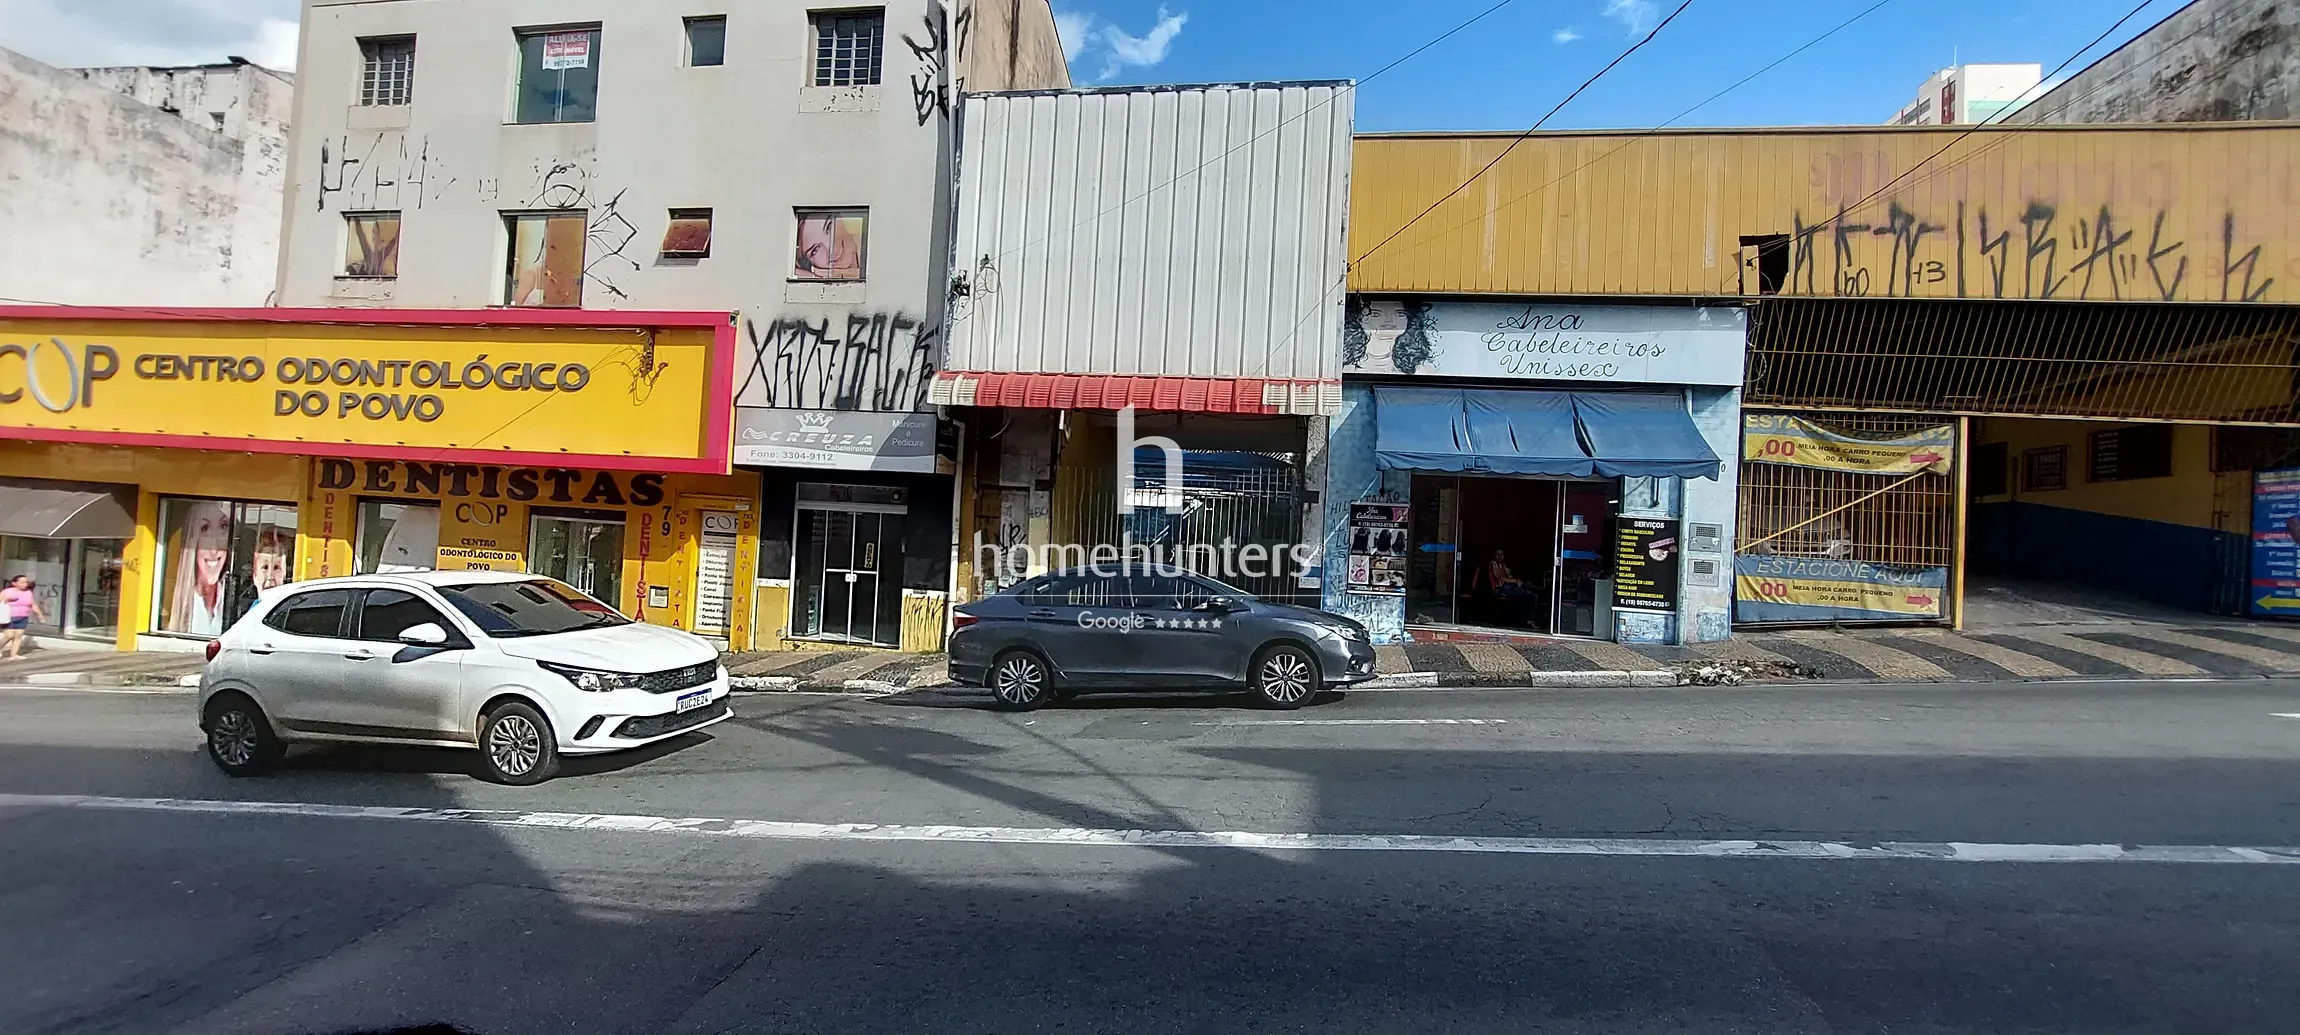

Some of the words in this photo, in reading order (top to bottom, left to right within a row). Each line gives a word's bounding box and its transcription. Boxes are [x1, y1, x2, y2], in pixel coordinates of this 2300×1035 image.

[1496, 306, 1585, 330] Ana
[1481, 330, 1666, 357] Cabeleireiros
[1499, 352, 1619, 377] Unissex
[0, 338, 120, 413] COP
[134, 354, 265, 383] CENTRO
[277, 354, 591, 392] ODONTOLÓGICO
[274, 390, 329, 417] DO
[338, 392, 444, 422] POVO
[892, 419, 926, 429] Manicure
[769, 432, 873, 445] CREUZA
[892, 438, 924, 447] Pedicure
[824, 444, 873, 453] Cabeleireiros
[1798, 443, 1816, 451] MEIA
[1818, 445, 1841, 453] HORA
[1842, 447, 1870, 455] CARRO
[750, 450, 779, 458] Fone:
[782, 451, 833, 461] 3304-9112
[1846, 457, 1871, 465] HORA
[318, 458, 667, 506] DENTISTAS
[455, 501, 508, 526] COP
[1634, 521, 1665, 529] SERVIÇOS
[461, 537, 496, 548] CENTRO
[504, 552, 517, 561] DO
[466, 562, 490, 571] POVO
[1757, 561, 1871, 579] ESTACIONE
[1861, 589, 1893, 597] PEQUENO
